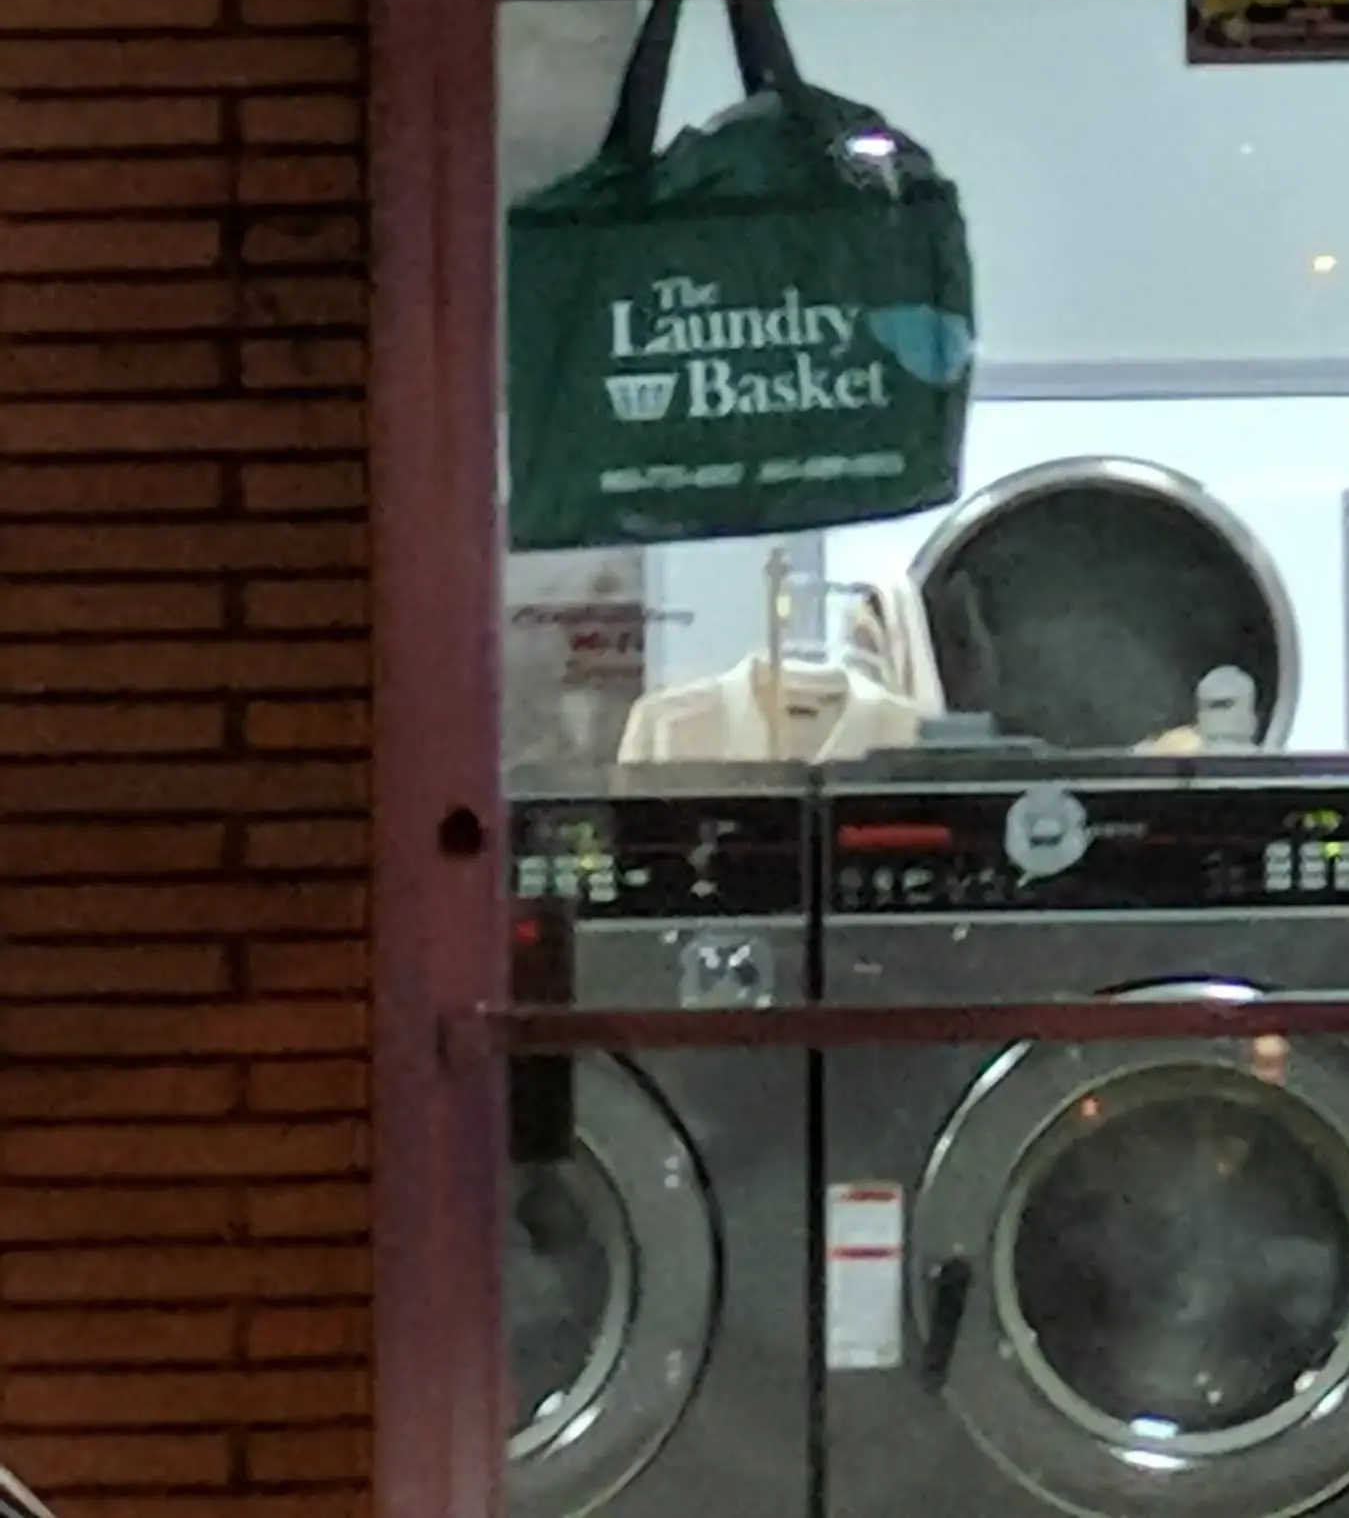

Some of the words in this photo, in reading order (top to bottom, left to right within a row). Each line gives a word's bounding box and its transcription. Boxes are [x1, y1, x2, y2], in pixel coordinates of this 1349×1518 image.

[611, 284, 861, 358] Laundry
[652, 276, 721, 310] The
[686, 351, 889, 418] Basket
